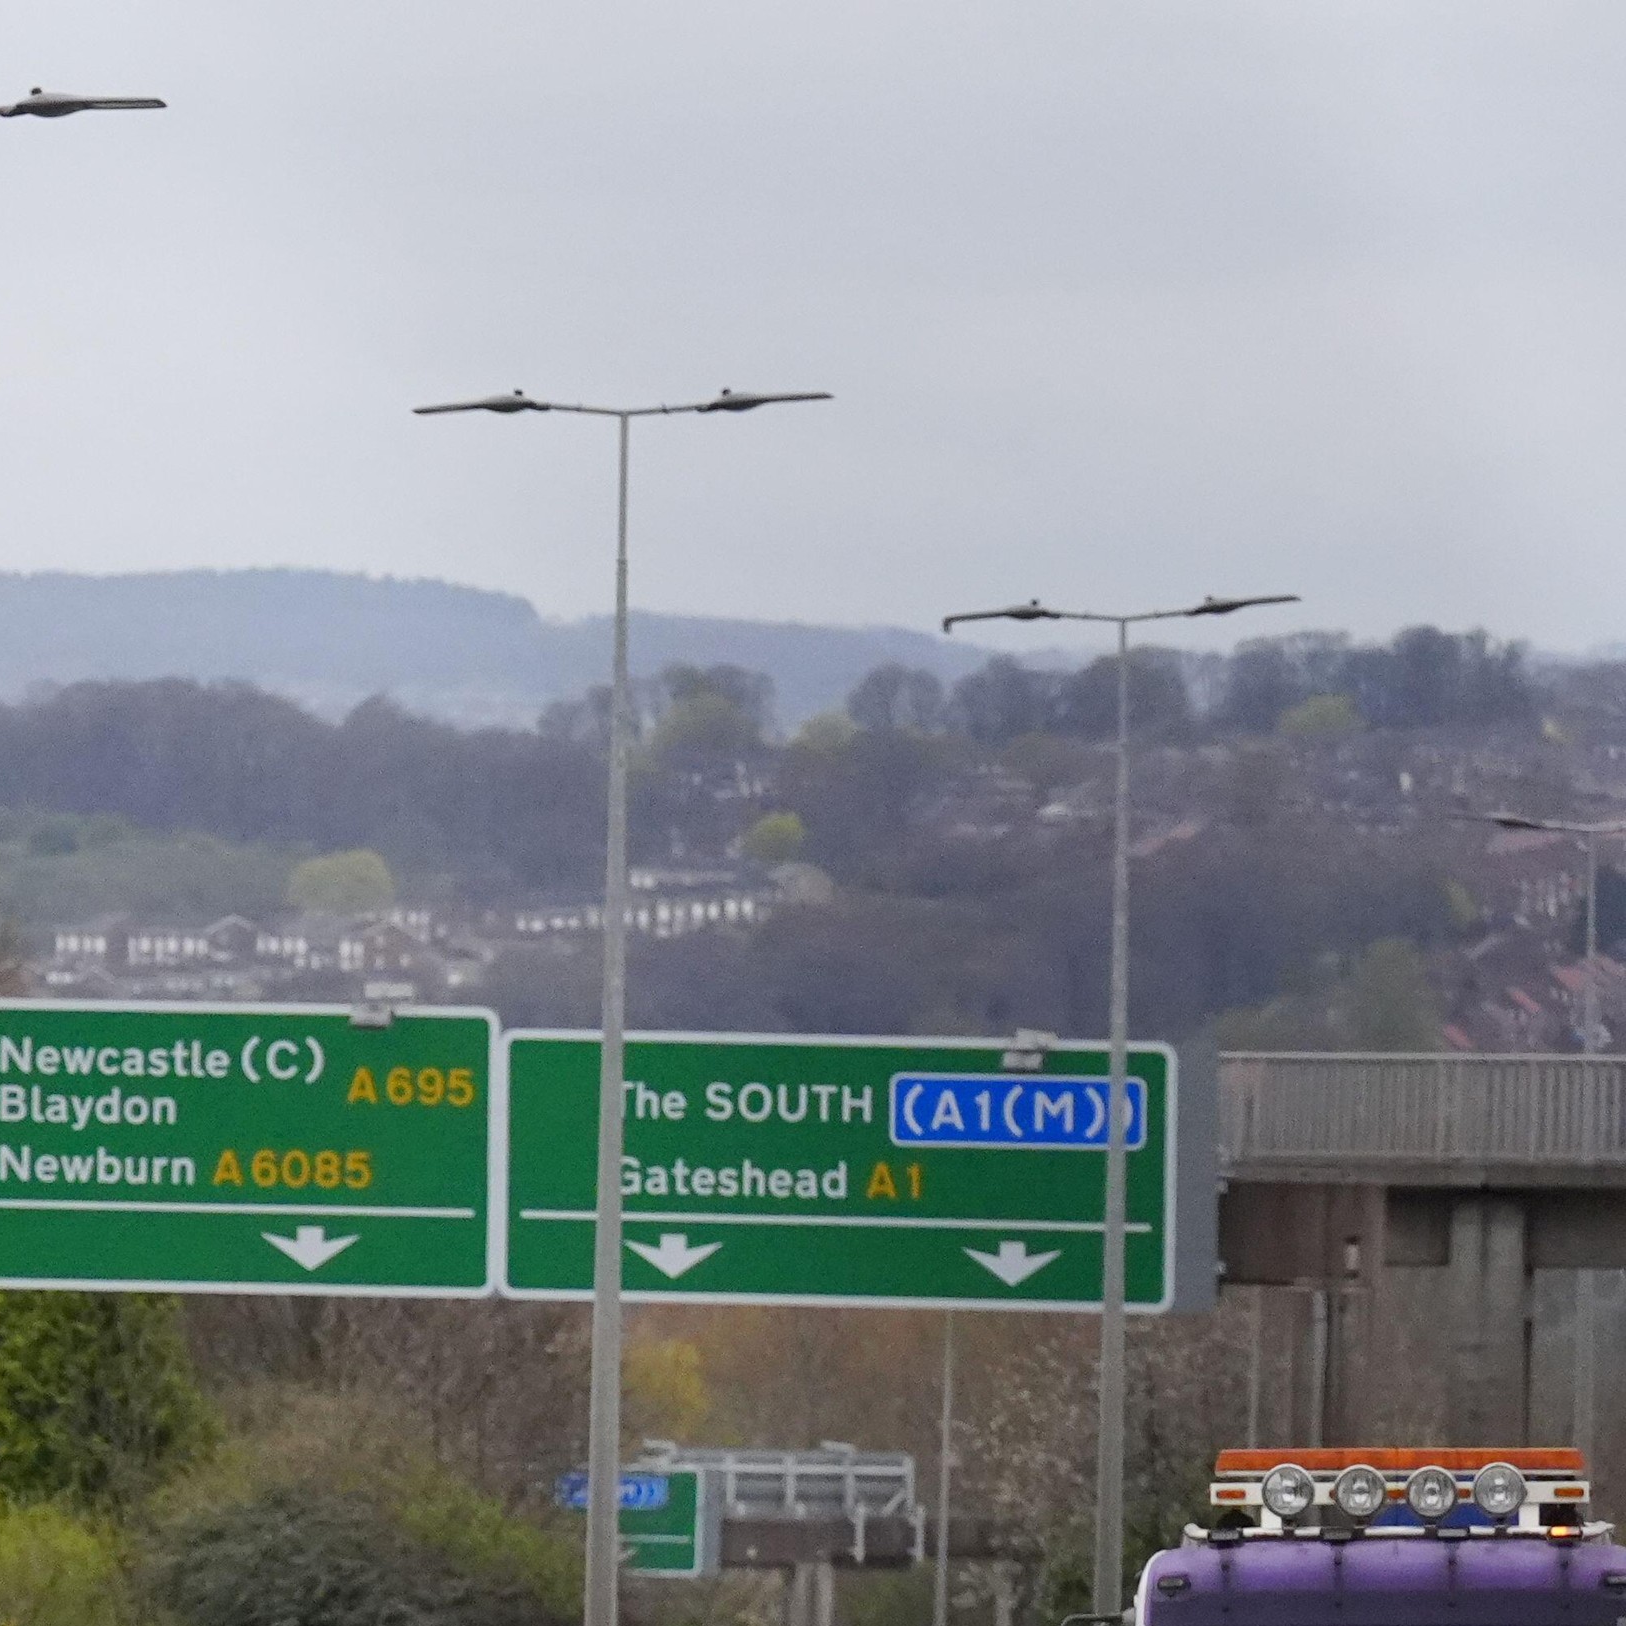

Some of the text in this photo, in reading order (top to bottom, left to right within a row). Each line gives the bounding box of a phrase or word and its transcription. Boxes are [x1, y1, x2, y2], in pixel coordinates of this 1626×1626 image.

[240, 1035, 325, 1084] (C)
[347, 1066, 476, 1106] A695
[704, 1081, 873, 1123] SOUTH
[211, 1149, 373, 1189] A6085
[619, 1156, 922, 1200] Gateshead A1
